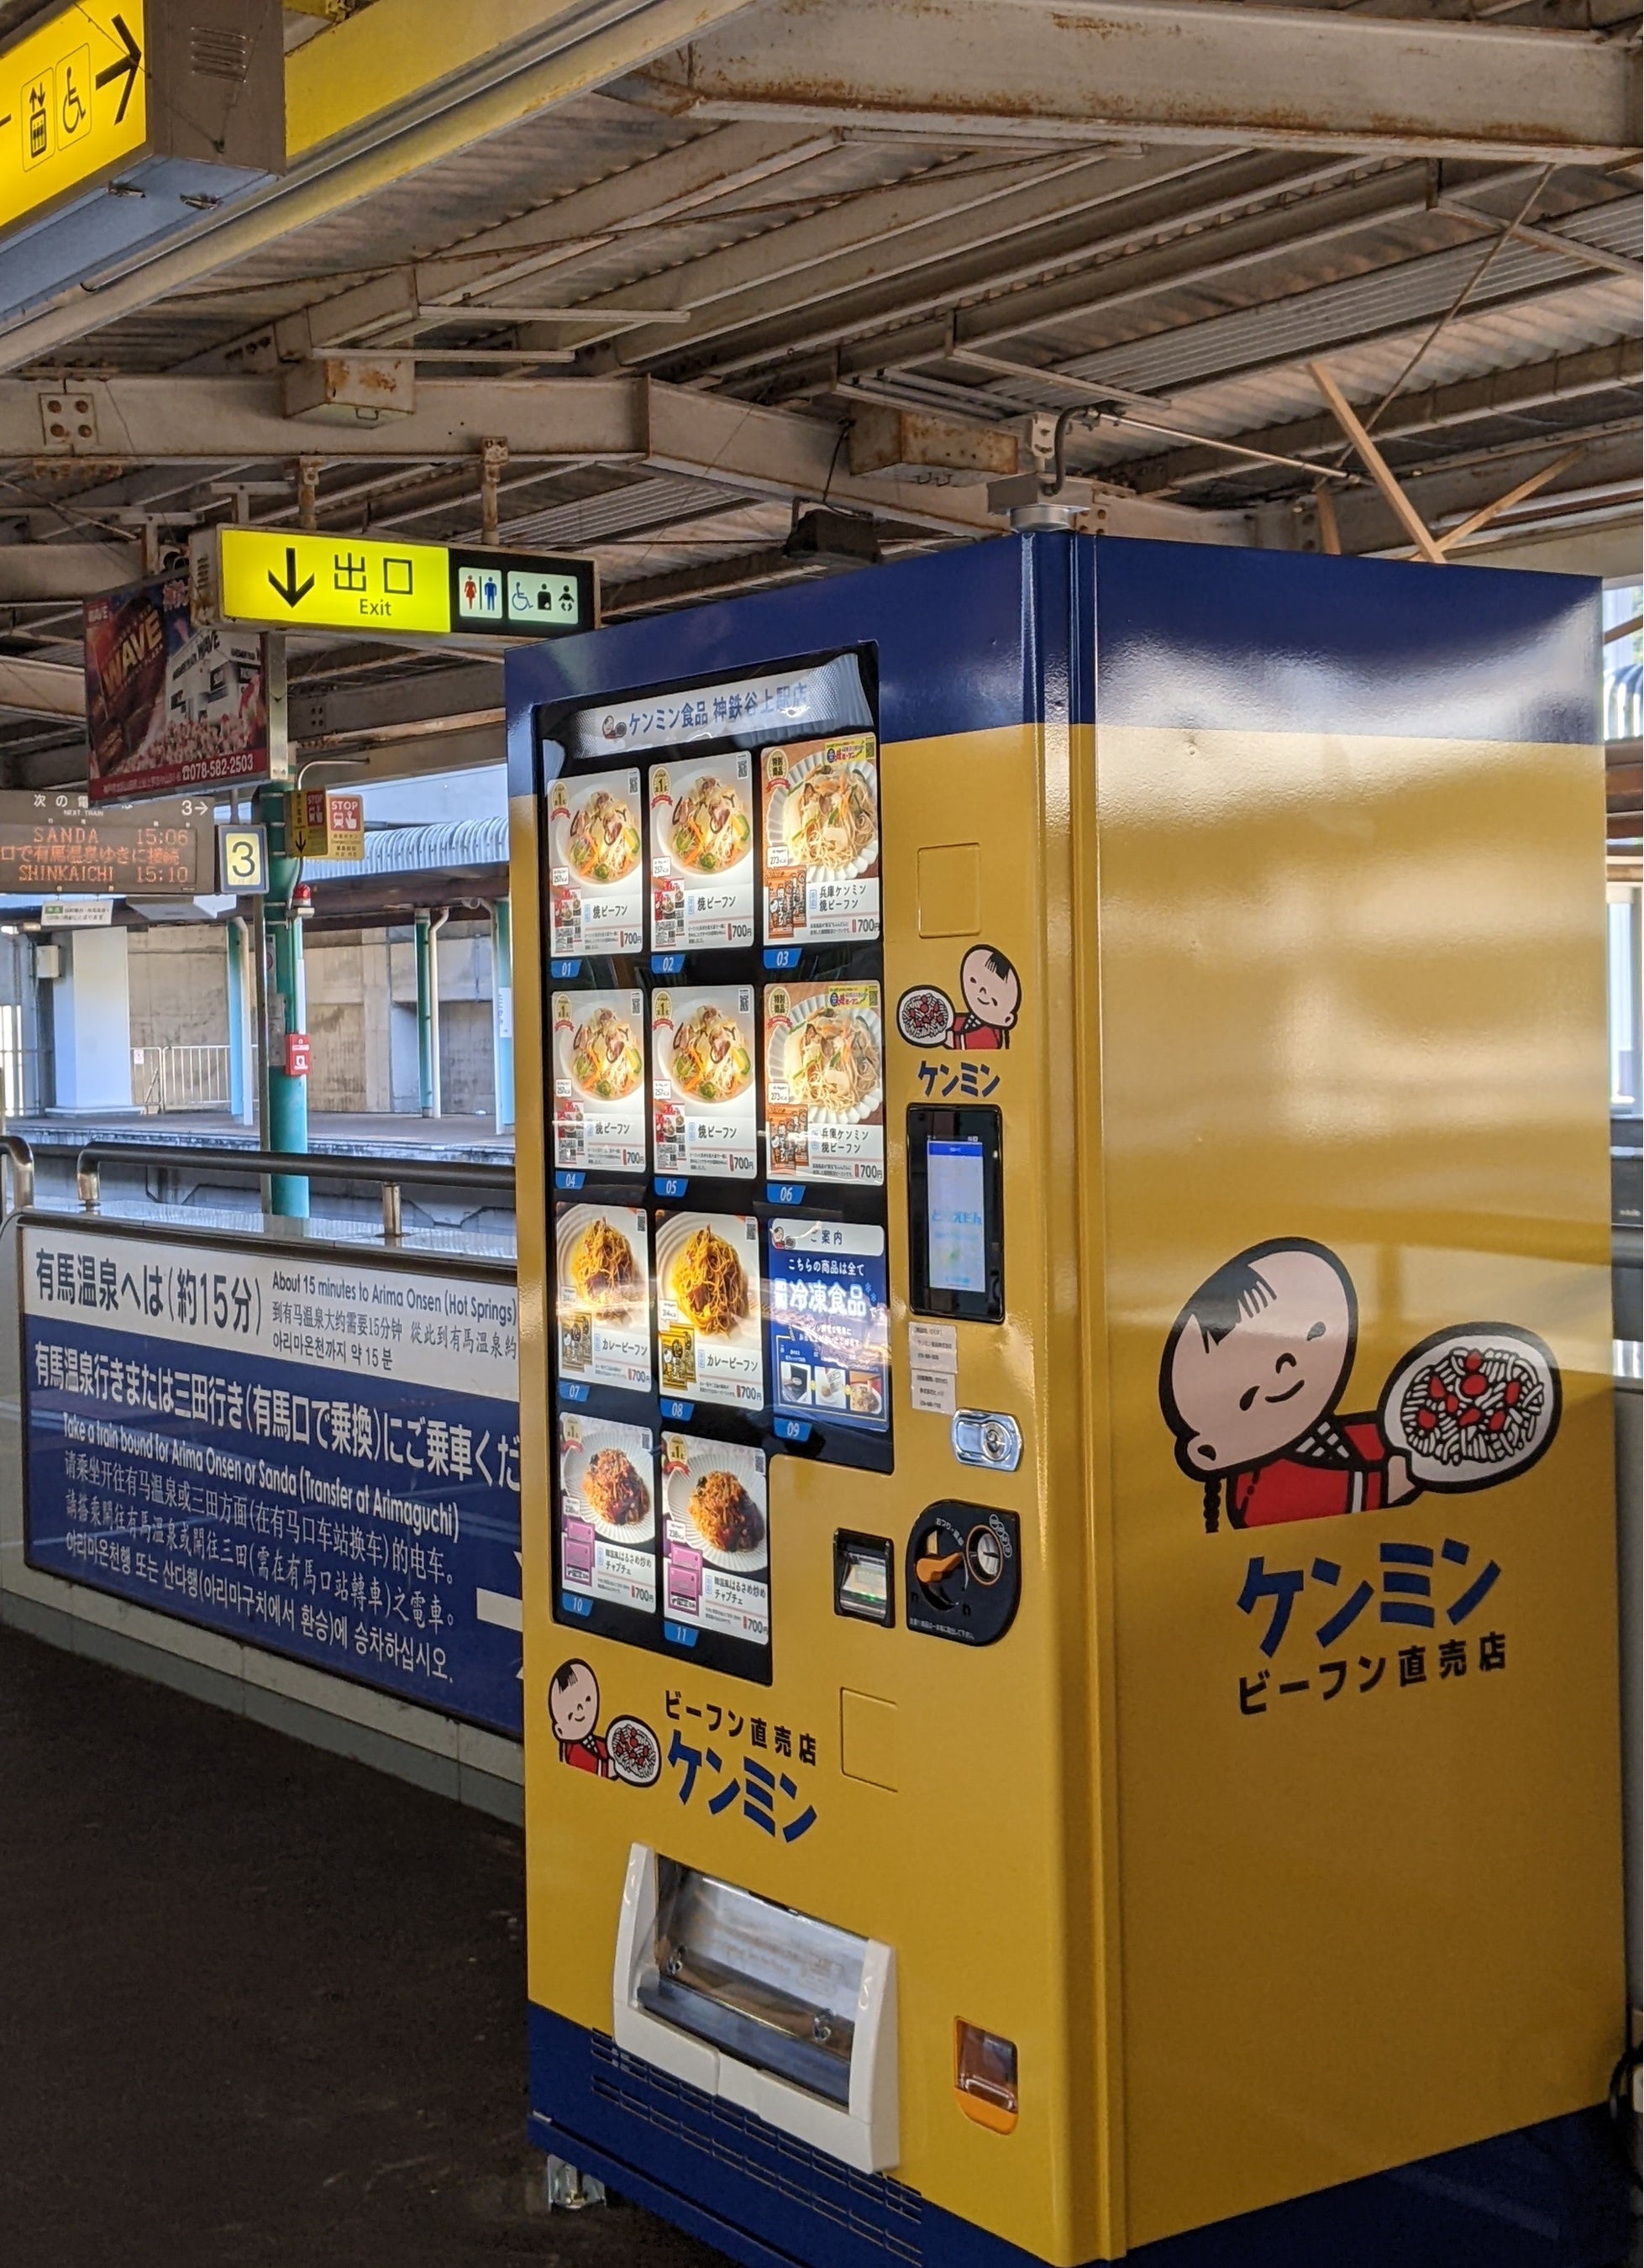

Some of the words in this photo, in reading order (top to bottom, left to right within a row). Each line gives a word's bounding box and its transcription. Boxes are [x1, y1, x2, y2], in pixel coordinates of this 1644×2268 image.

[334, 552, 413, 596] 出口
[360, 598, 392, 617] Exit
[100, 610, 163, 697] WAVE
[630, 701, 709, 737] ケンミン食品
[189, 753, 254, 780] 078-582-2503
[181, 800, 192, 816] 3
[331, 801, 358, 811] STOP
[34, 827, 99, 843] SANDA
[137, 828, 189, 846] 15:06
[232, 841, 255, 878] 3
[18, 864, 114, 882] SHINKAICHI
[137, 866, 189, 883] 15:10
[819, 885, 866, 898] 兵庫ケンミン
[697, 896, 736, 911] 焼ビーフン
[819, 900, 859, 912] 焼ビーフン
[592, 905, 628, 919] 焼ビーフン
[733, 925, 752, 938] 700円
[858, 919, 880, 932] 700円
[624, 932, 642, 946] 700円
[662, 957, 674, 972] 02
[776, 950, 789, 966] 03
[561, 962, 571, 976] 01
[918, 1060, 1001, 1097] ケンミン
[596, 1122, 630, 1135] 焼ビーフン
[698, 1124, 737, 1139] 焼ビーフン
[821, 1142, 861, 1153] 焼ビーフン
[627, 1149, 644, 1164] 700円
[733, 1156, 754, 1170] 700円
[860, 1164, 883, 1179] 700円
[565, 1173, 575, 1187] 04
[665, 1179, 677, 1194] 05
[780, 1186, 792, 1202] 06
[788, 1257, 865, 1276] こちらの商品は全て
[36, 1247, 261, 1336] 有馬温泉へは(約15分)
[272, 1271, 301, 1294] About
[302, 1274, 316, 1295] 15
[318, 1277, 356, 1300] minutes
[359, 1281, 369, 1301] to
[372, 1284, 403, 1307] Arima
[406, 1288, 442, 1312] Onsen
[444, 1289, 468, 1317] (Hot
[470, 1294, 517, 1327] Springs)
[790, 1278, 867, 1317] 冷凍食品
[272, 1300, 403, 1342] 到有马温泉大约需要15分钟
[273, 1331, 347, 1363] 아리마온천까지
[351, 1344, 362, 1367] 약
[365, 1346, 379, 1368] 15
[381, 1347, 393, 1371] 분
[602, 1338, 648, 1356] カレービーフン
[706, 1354, 758, 1372] カレービーフン
[569, 1385, 580, 1399] 07
[742, 1386, 762, 1401] 700円
[671, 1402, 683, 1417] 08
[787, 1421, 800, 1436] 09
[63, 1411, 86, 1442] Take
[88, 1425, 95, 1444] a
[96, 1420, 118, 1449] train
[120, 1424, 154, 1460] bound
[155, 1432, 170, 1463] for
[171, 1438, 204, 1472] Arima
[206, 1446, 243, 1482] Onsen
[244, 1463, 256, 1486] or
[259, 1458, 297, 1497] Sanda
[299, 1465, 353, 1511] (Transfer
[356, 1485, 370, 1512] at
[373, 1486, 460, 1544] Arimaguchi)
[635, 1588, 654, 1603] 700円
[1236, 1537, 1502, 1658] ケンミン
[66, 1529, 131, 1576] 아리마온천행
[135, 1552, 159, 1584] 또는
[162, 1559, 295, 1632] 산다행(아리마구치에서
[300, 1604, 348, 1650] 환승)에
[354, 1621, 454, 1684] 승차하십시오.
[573, 1597, 583, 1612] 10
[677, 1626, 686, 1642] 11
[1239, 1631, 1507, 1715] ビーフン直売店
[664, 1689, 817, 1767] ビーフン直売店
[667, 1729, 818, 1843] ケンミン
